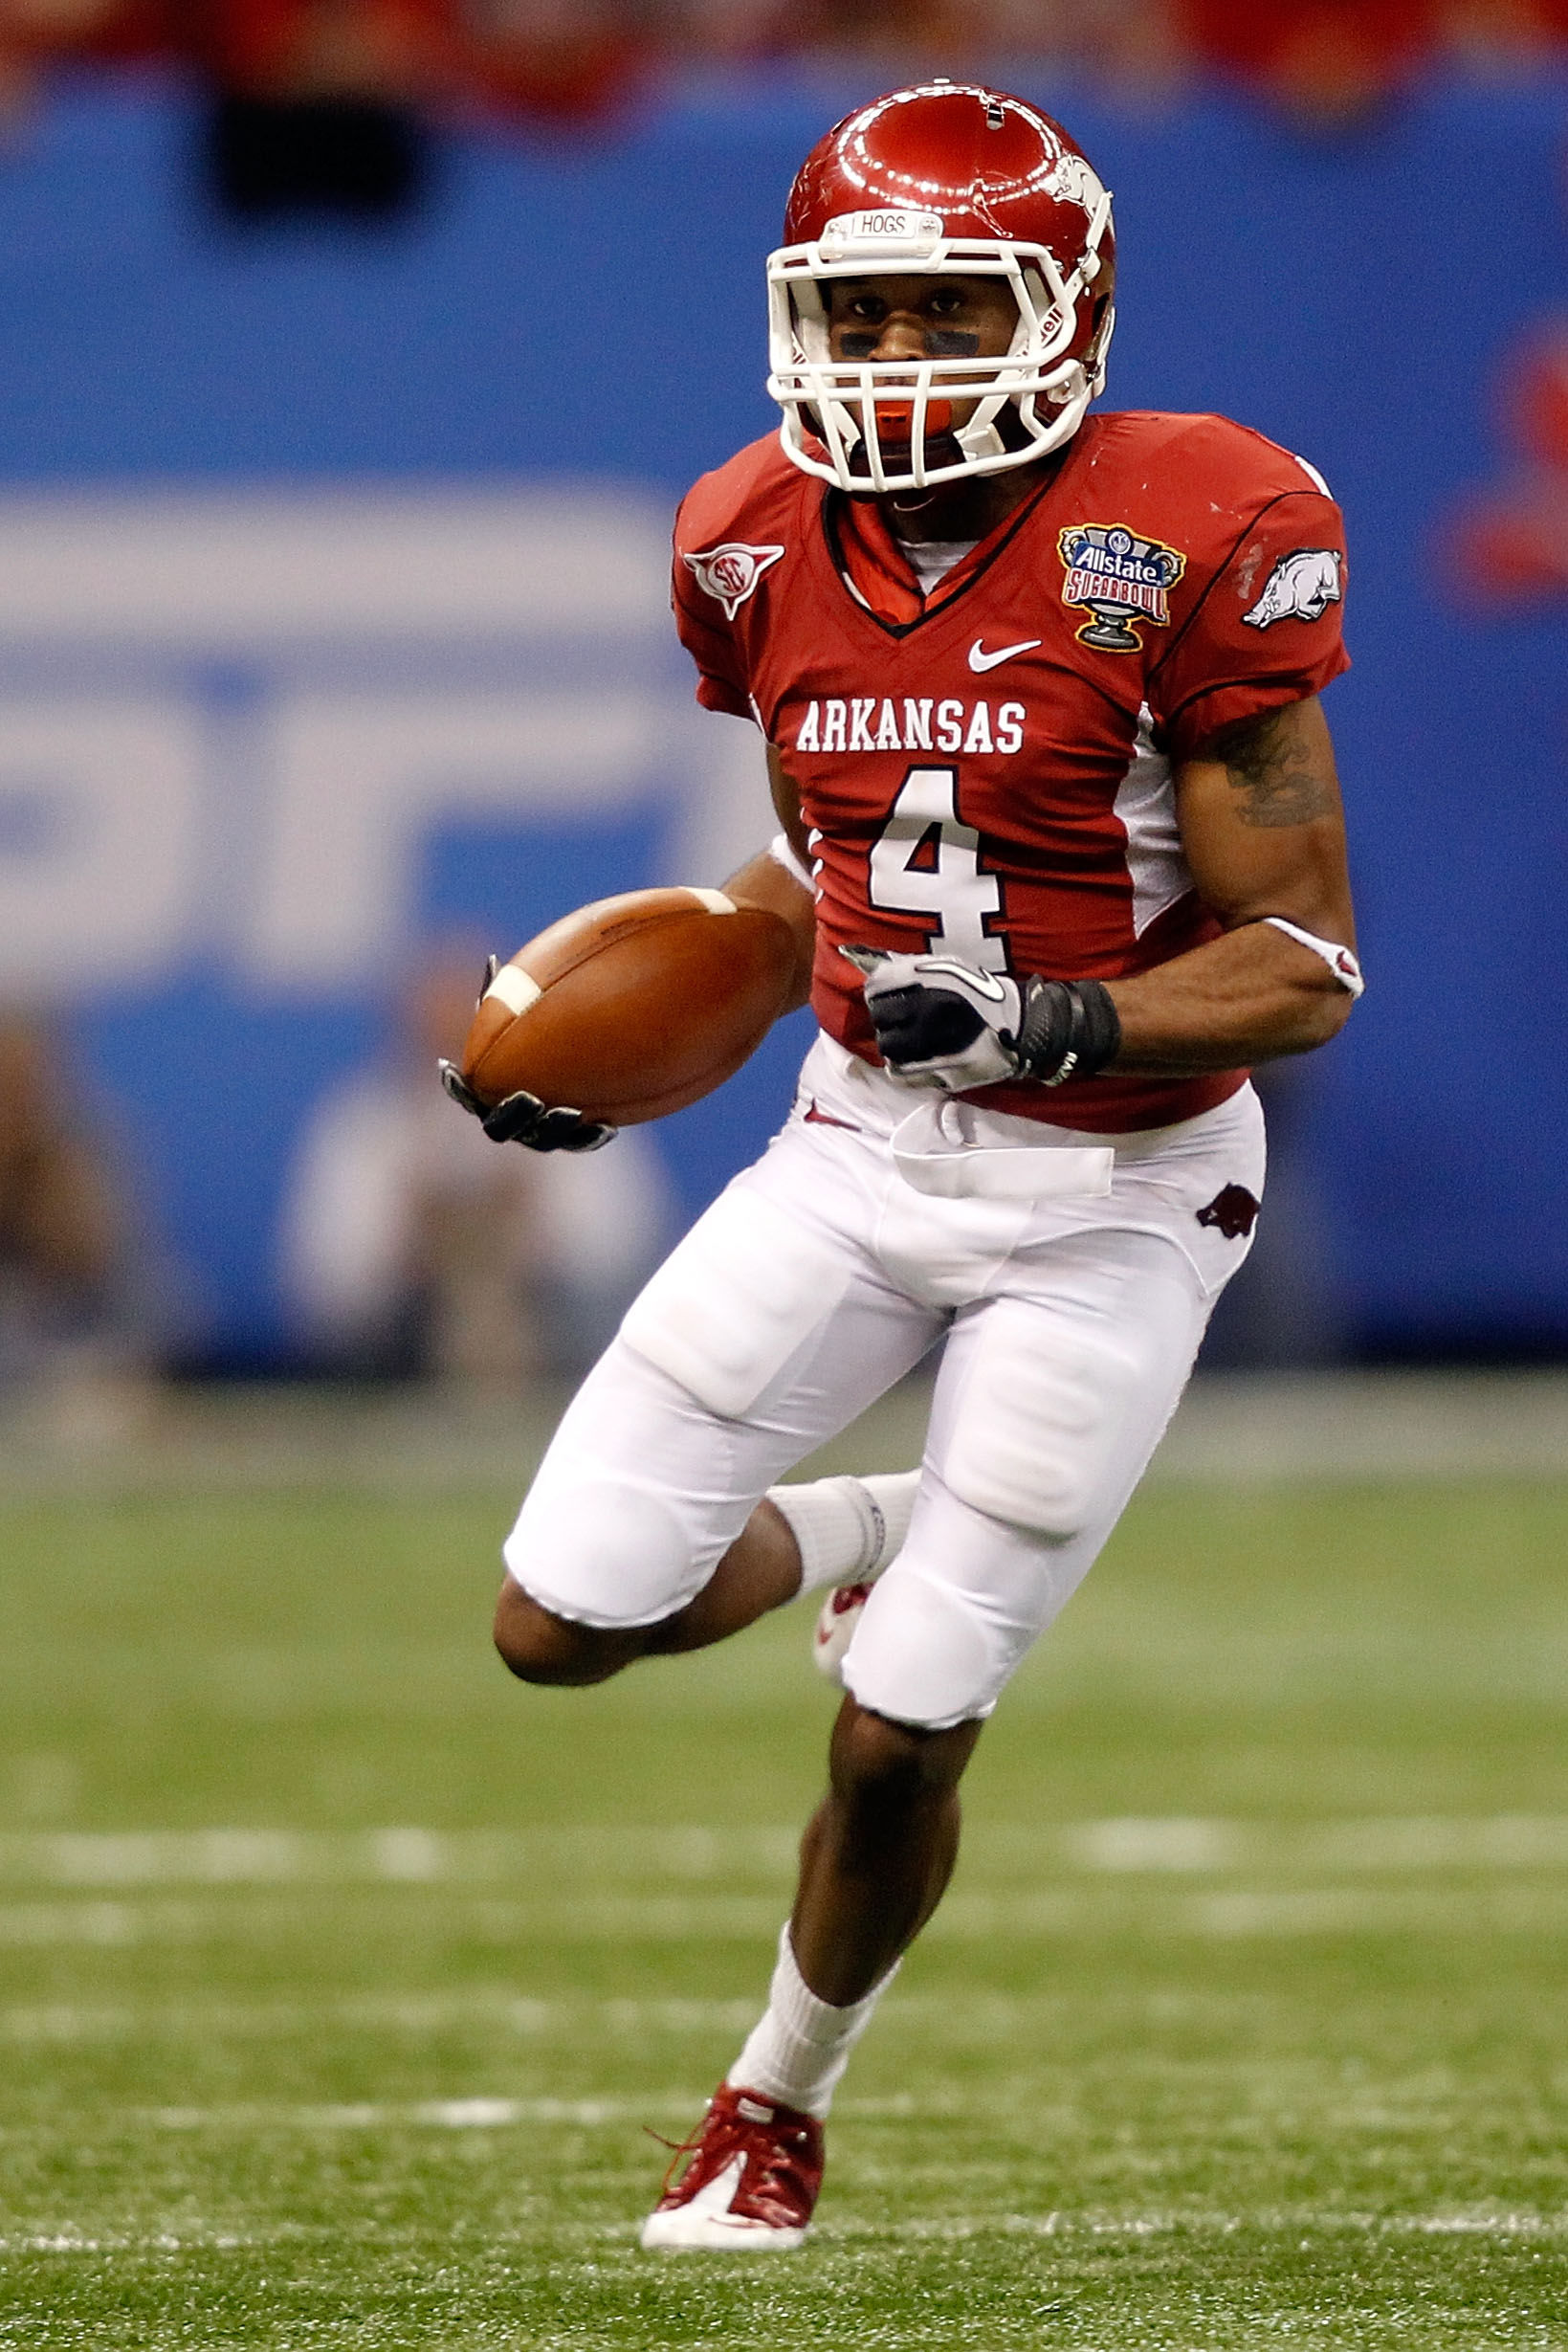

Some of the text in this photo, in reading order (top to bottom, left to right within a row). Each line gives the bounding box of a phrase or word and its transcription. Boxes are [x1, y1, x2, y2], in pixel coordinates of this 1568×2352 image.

[862, 215, 905, 234] HOGS
[714, 556, 745, 592] SEC
[1074, 547, 1158, 584] Allstate
[796, 698, 1027, 754] ARKANSAS
[869, 765, 1010, 974] 4
